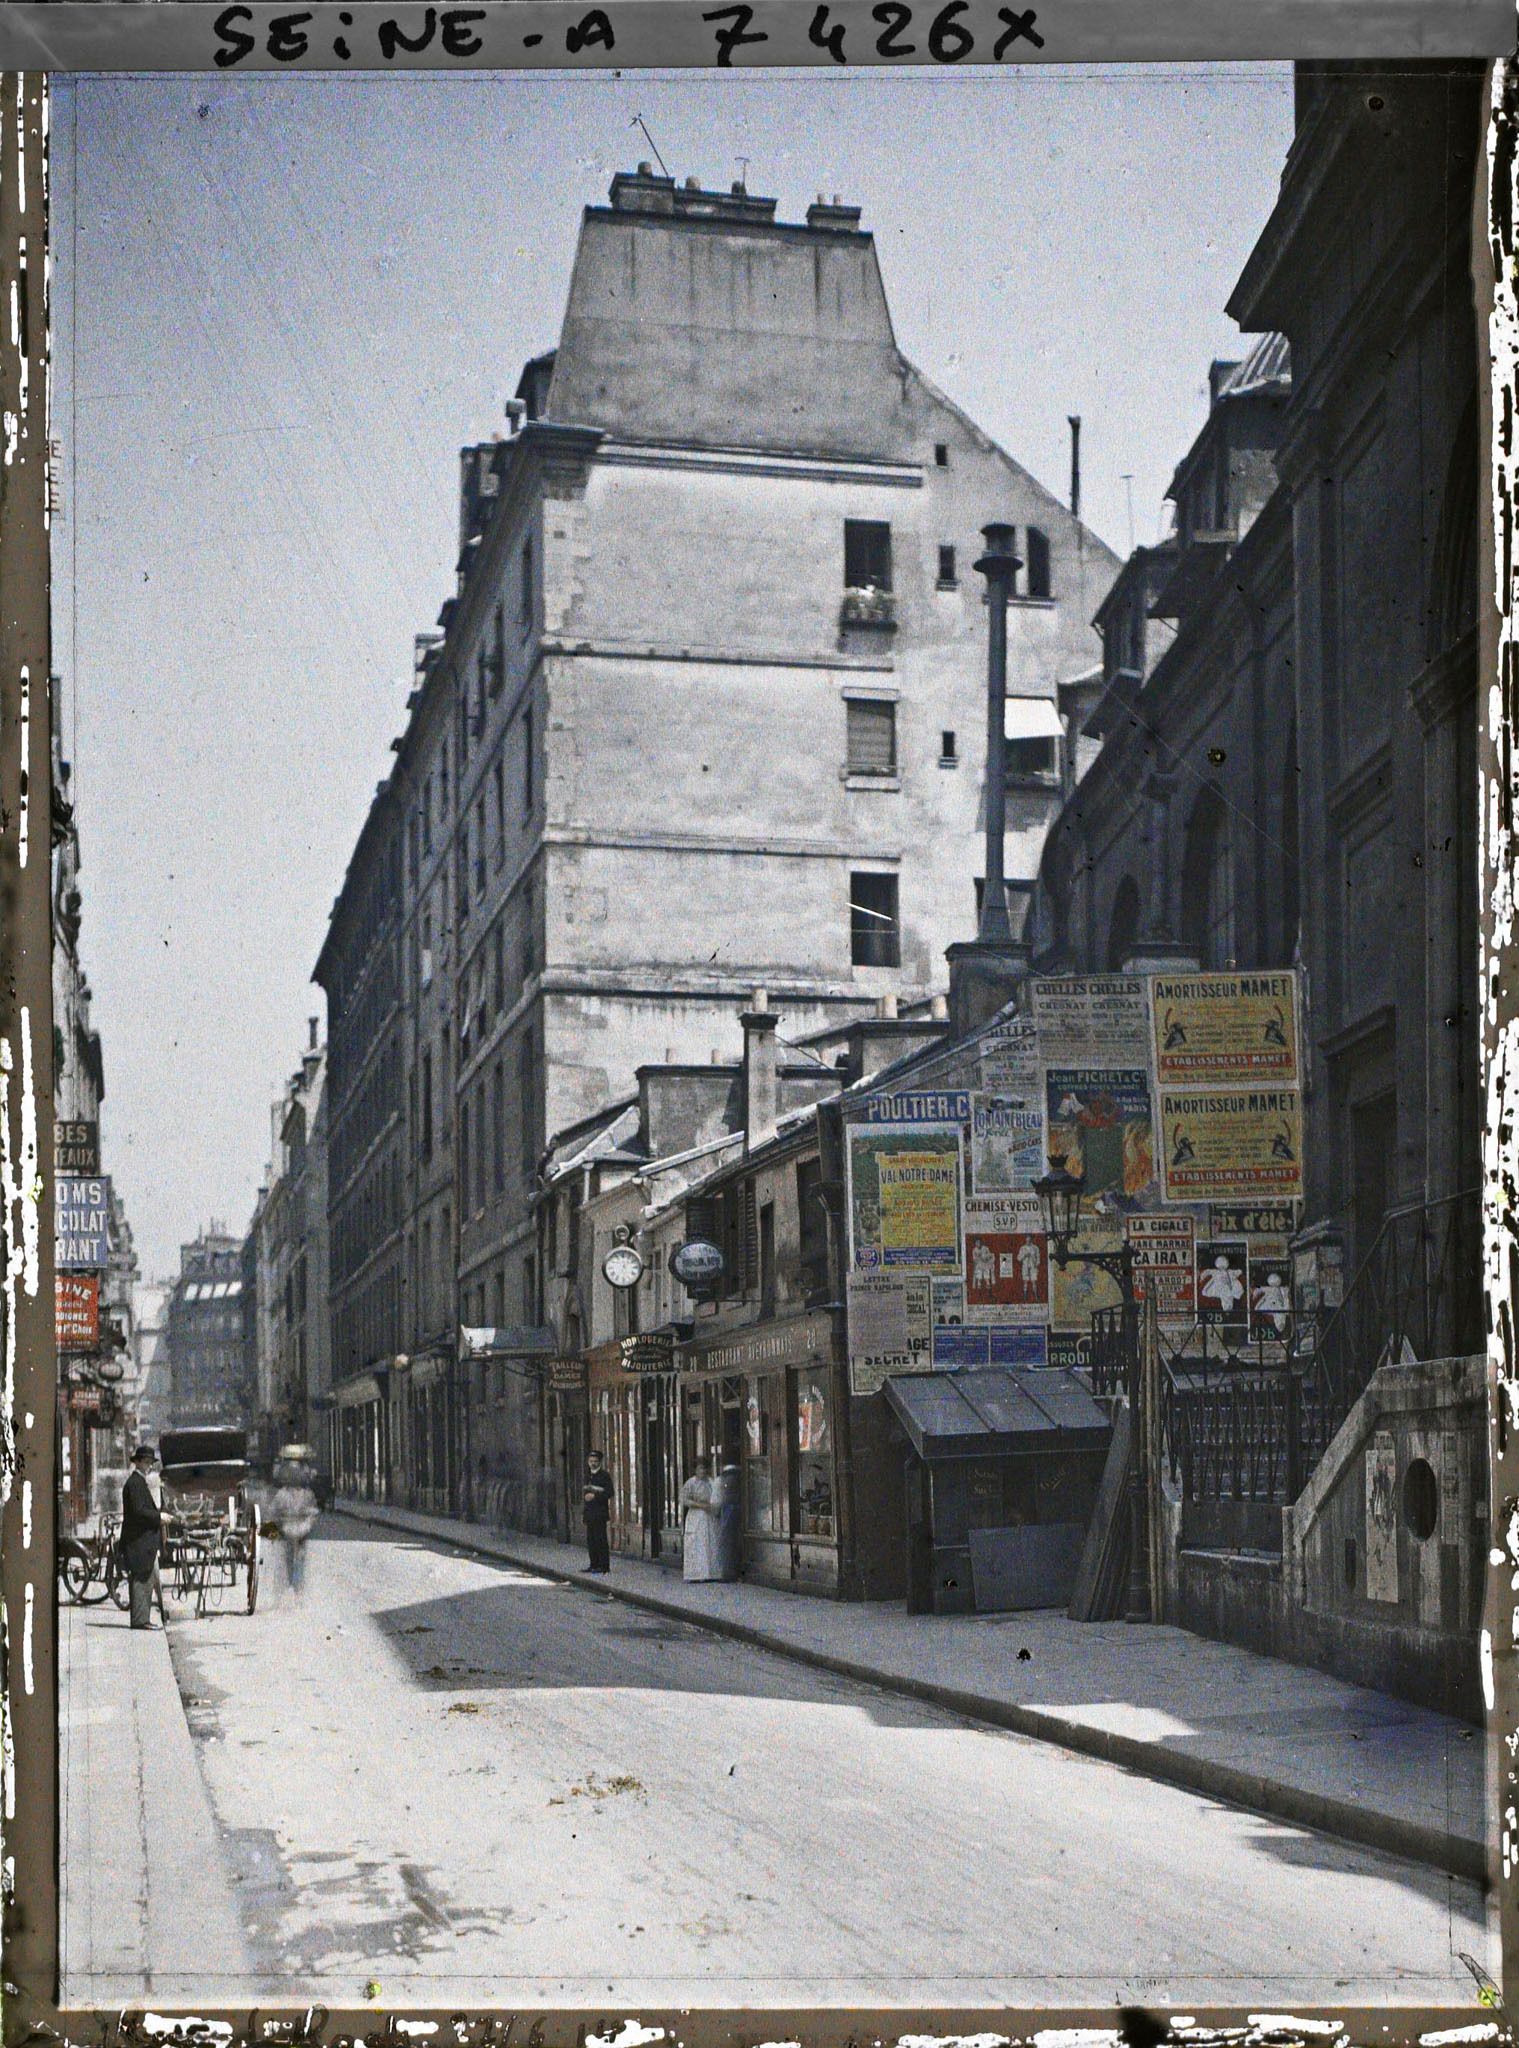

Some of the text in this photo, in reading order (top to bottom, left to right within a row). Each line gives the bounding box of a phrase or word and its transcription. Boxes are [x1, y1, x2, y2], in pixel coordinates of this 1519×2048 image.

[1156, 978, 1288, 999] AMORTISSEUR MAMET
[1252, 1053, 1287, 1064] MAMET
[1048, 1072, 1075, 1083] Jean
[1077, 1071, 1124, 1083] FICHET
[868, 1096, 948, 1120] POULTIER
[1165, 1093, 1296, 1114] AMORTISSEUR MAMET
[53, 1124, 88, 1143] BES
[881, 1168, 955, 1184] VAL NOTRE DAME
[1260, 1169, 1295, 1181] MAMET
[56, 1182, 102, 1204] OMS
[1132, 1221, 1145, 1232] LA
[1150, 1220, 1189, 1232] CIGALE
[56, 1238, 101, 1261] RANT
[1155, 1251, 1178, 1265] IRA
